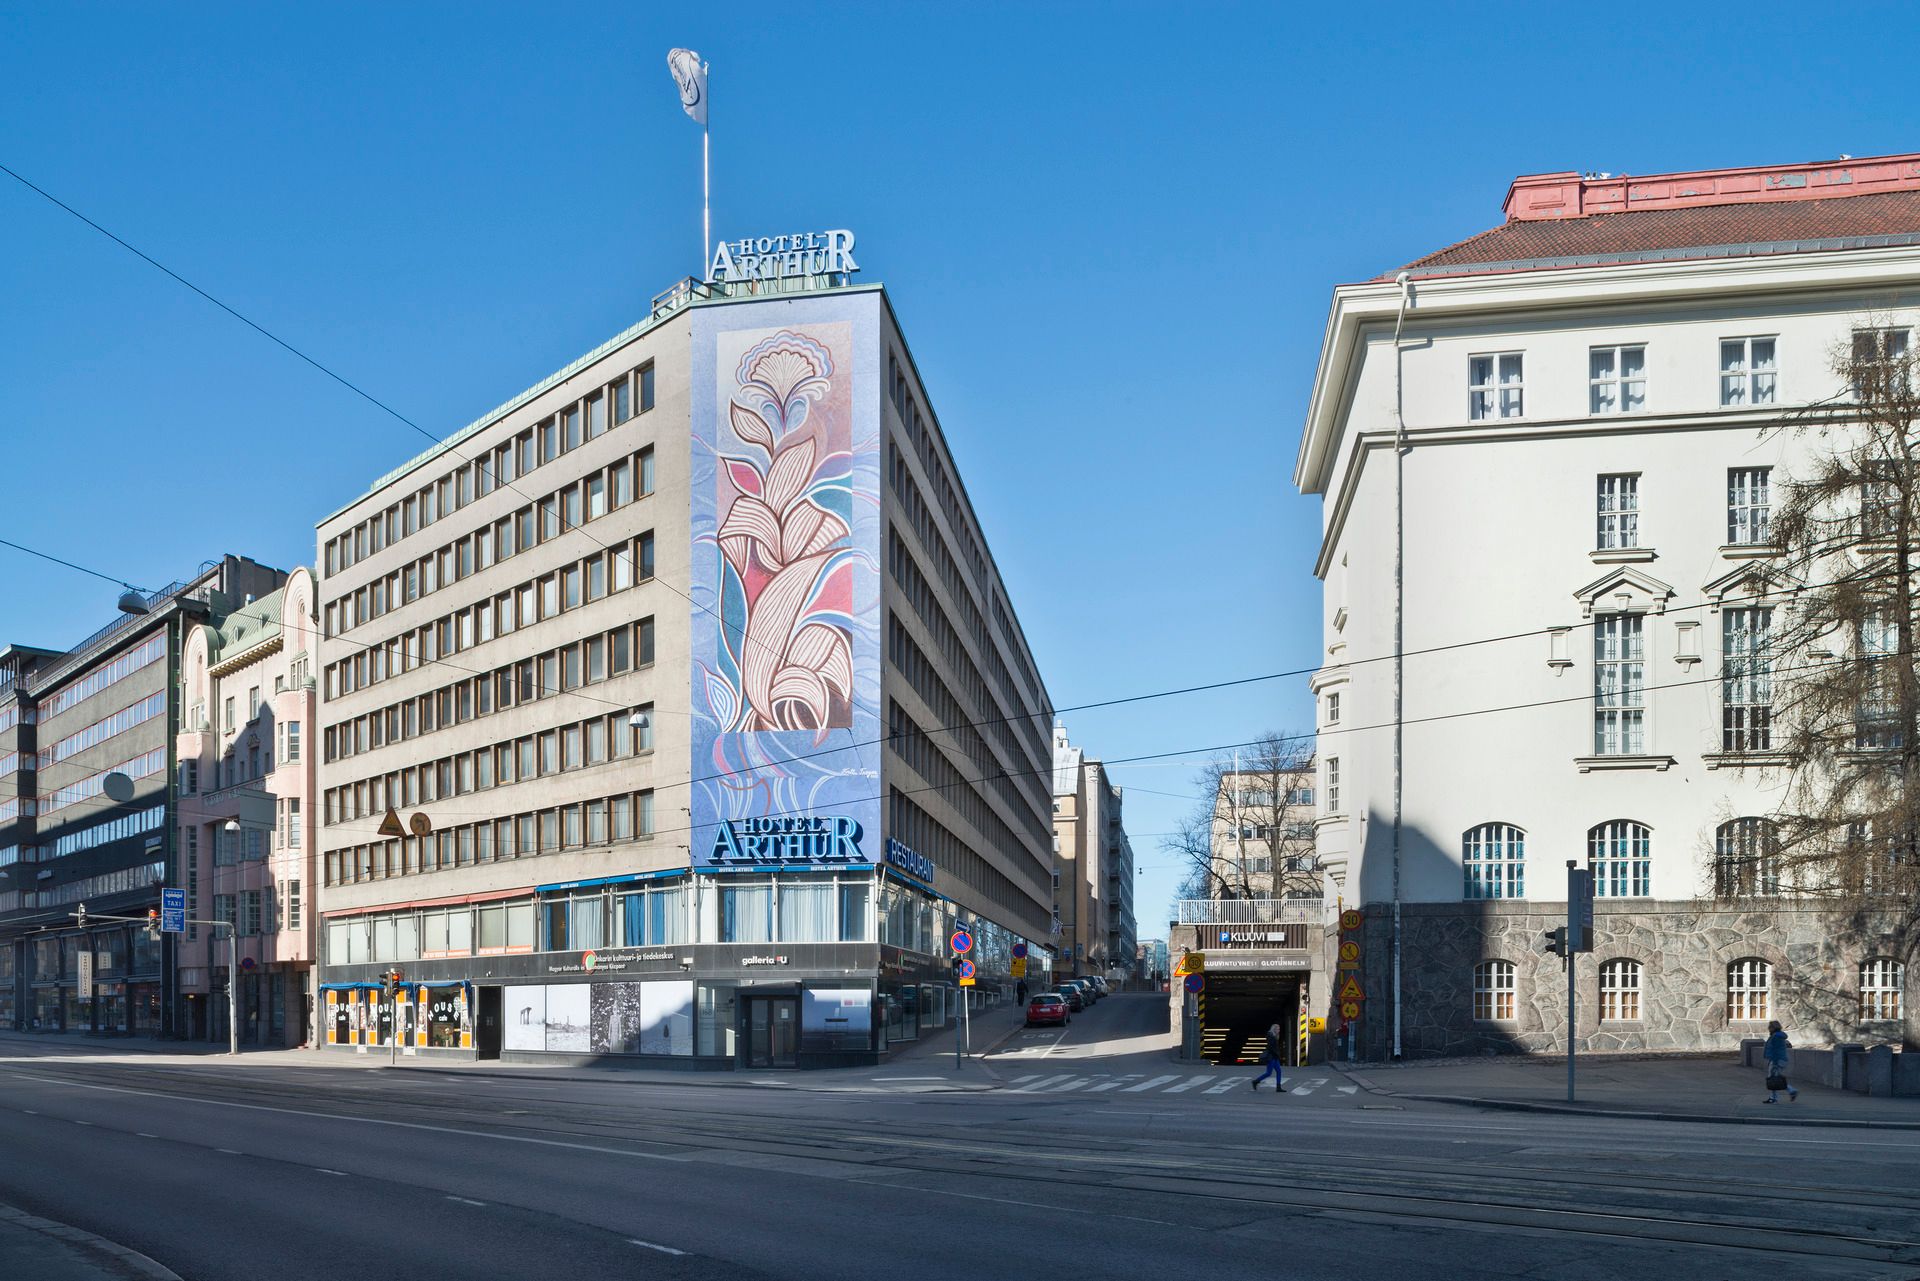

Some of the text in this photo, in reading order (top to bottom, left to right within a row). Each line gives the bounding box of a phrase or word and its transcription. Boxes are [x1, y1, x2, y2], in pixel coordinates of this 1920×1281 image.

[739, 232, 821, 256] HOTEL
[702, 229, 860, 283] ARTHUR
[742, 816, 823, 833] HOTEL
[706, 815, 863, 860] ARTHUR
[891, 837, 935, 883] RESTAURANT
[1345, 915, 1358, 926] 30
[1231, 932, 1265, 942] KLUUVI
[742, 955, 775, 966] galleria
[428, 1001, 460, 1021] HOUSE
